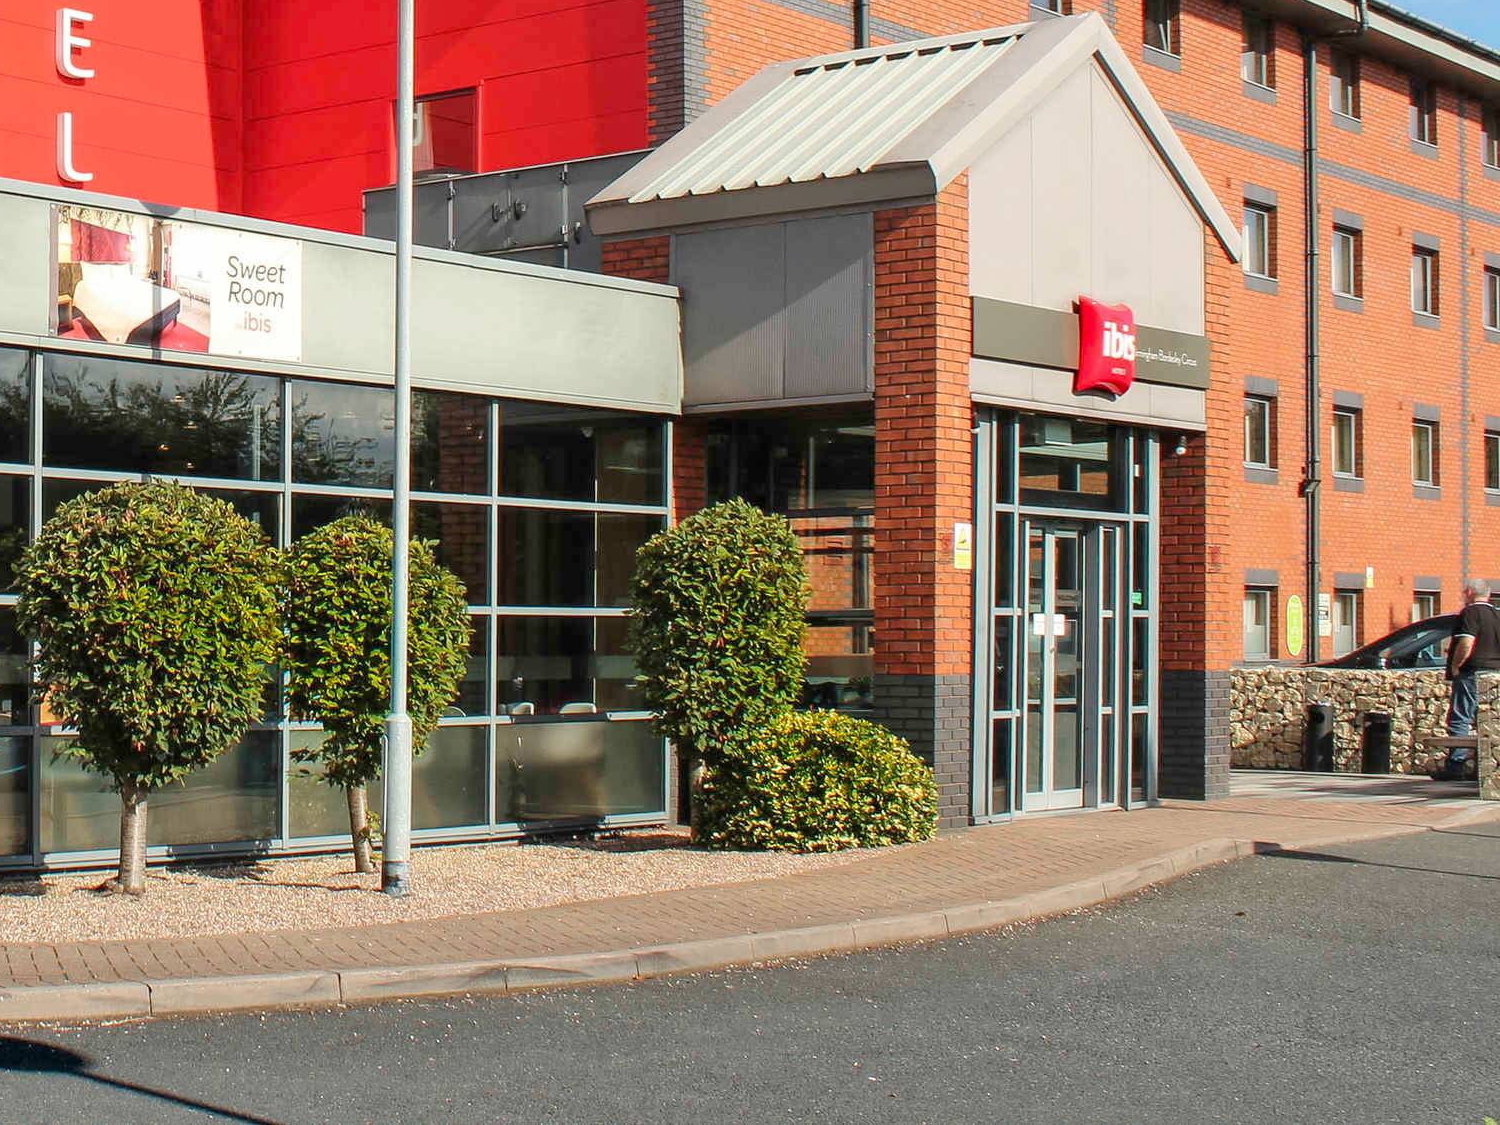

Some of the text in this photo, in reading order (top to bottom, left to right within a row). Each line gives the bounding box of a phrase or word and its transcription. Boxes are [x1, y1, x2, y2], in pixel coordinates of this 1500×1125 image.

[226, 255, 286, 284] Sweet
[228, 281, 284, 309] Room
[243, 310, 272, 333] ibis
[1102, 321, 1137, 362] ibis
